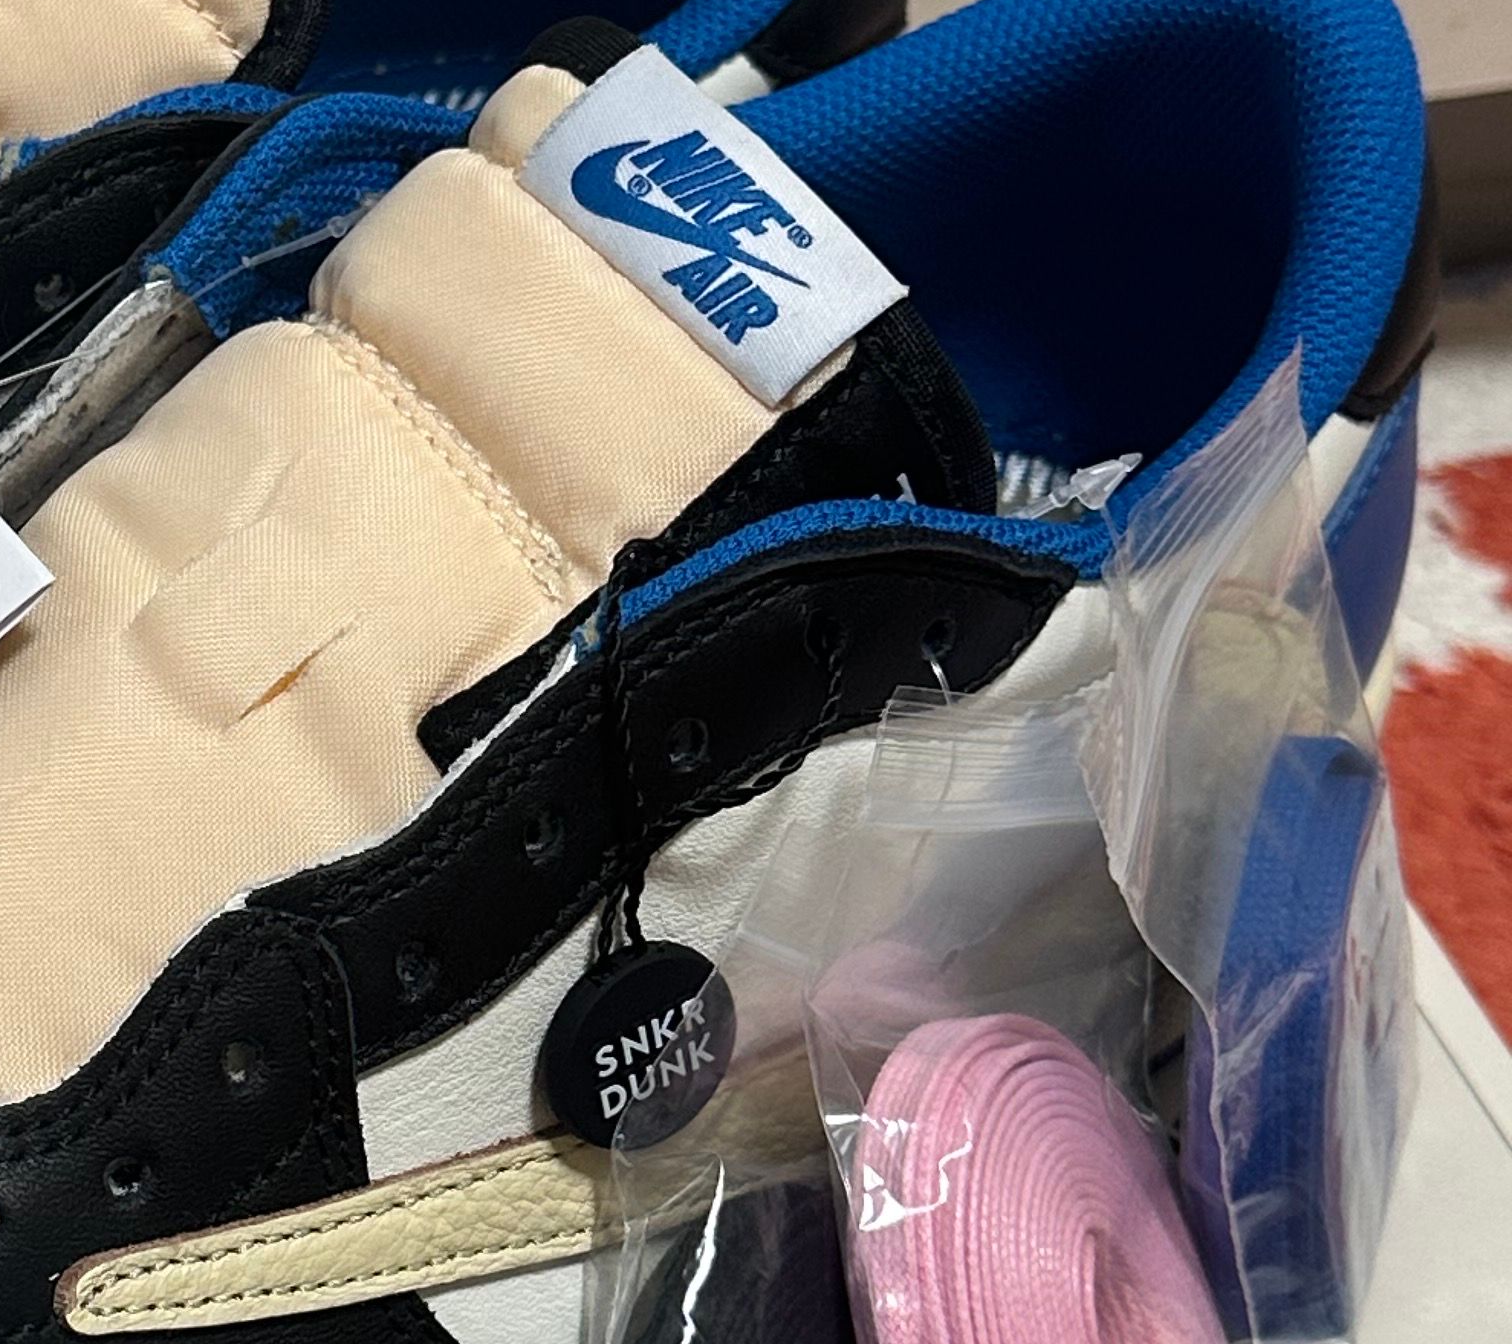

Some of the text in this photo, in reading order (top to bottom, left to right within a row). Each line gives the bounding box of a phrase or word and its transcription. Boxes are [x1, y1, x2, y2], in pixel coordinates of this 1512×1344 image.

[629, 129, 795, 247] NIKE
[661, 256, 779, 346] AIR
[595, 998, 705, 1078] SNKR
[600, 1032, 715, 1119] DUNK
